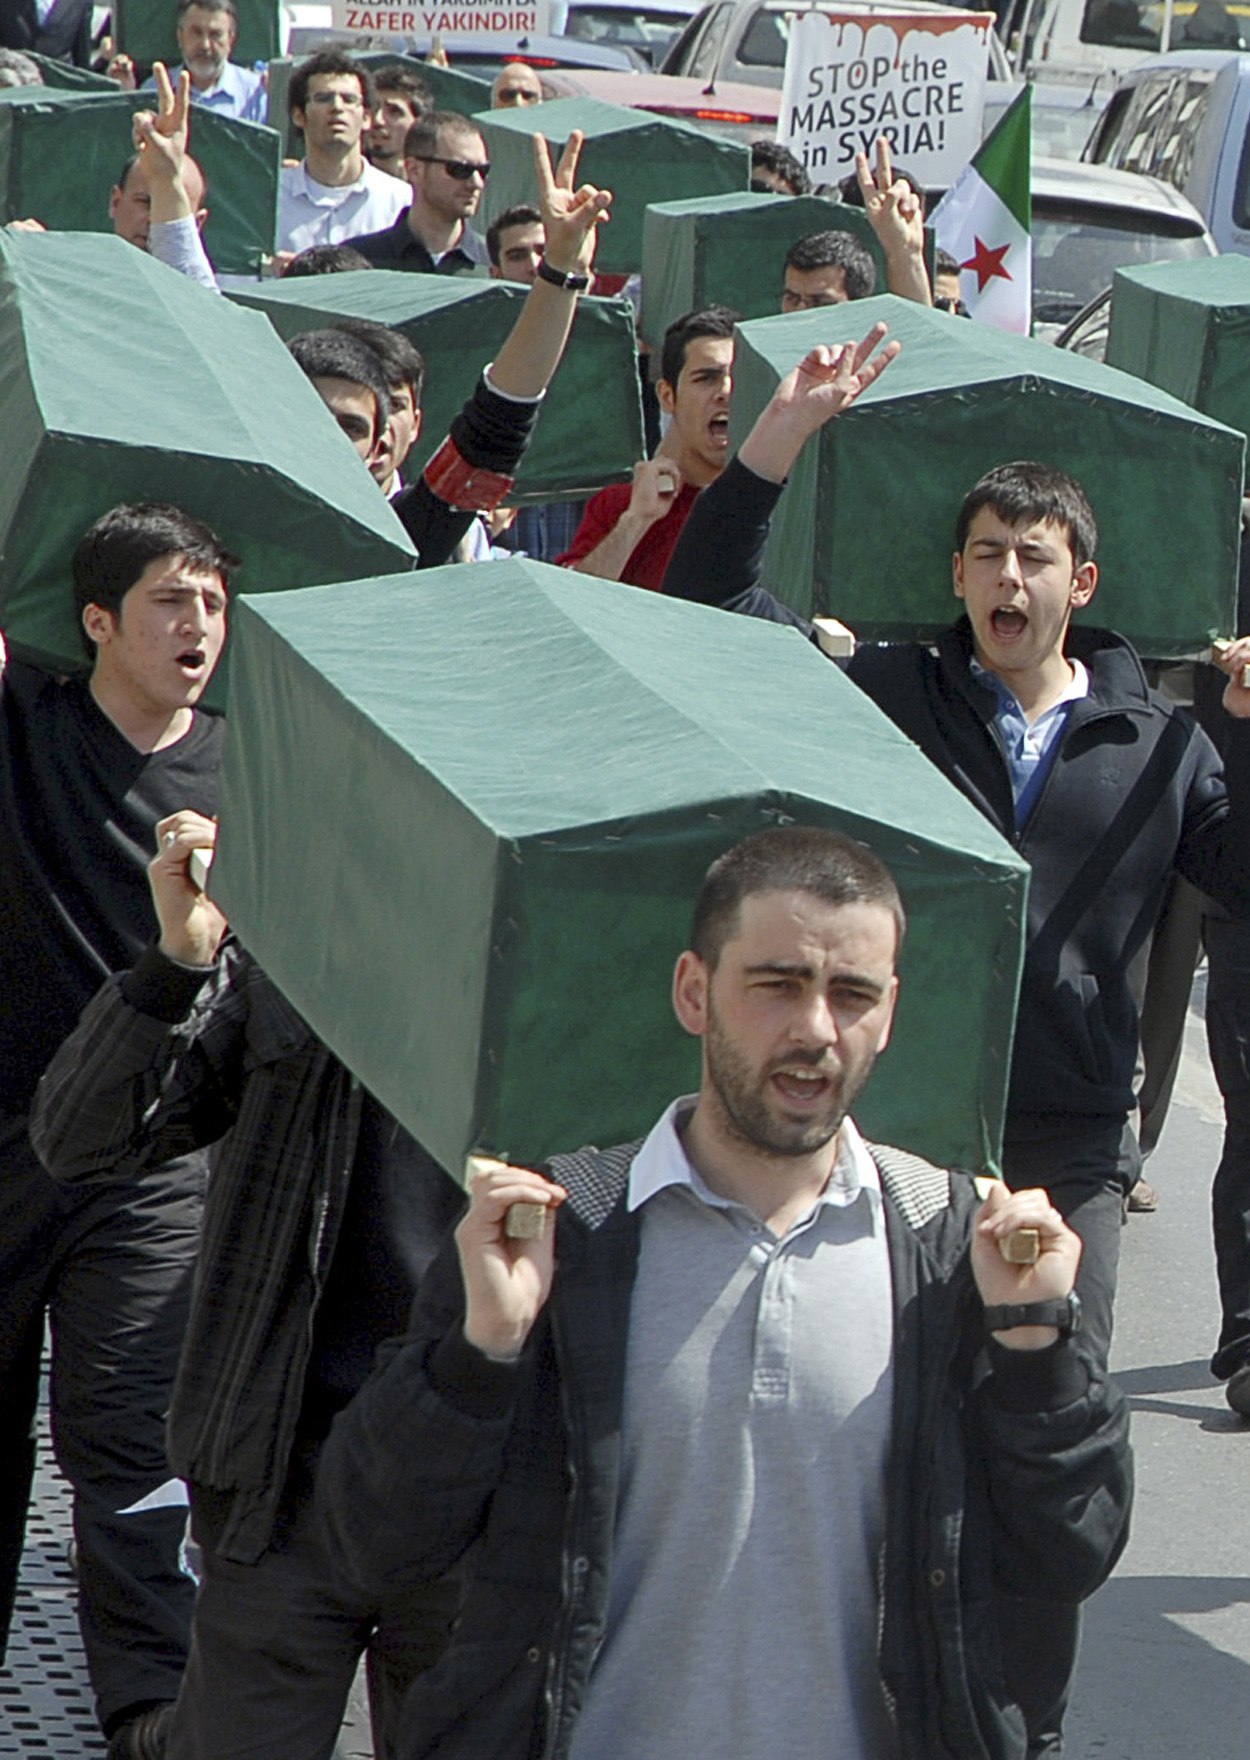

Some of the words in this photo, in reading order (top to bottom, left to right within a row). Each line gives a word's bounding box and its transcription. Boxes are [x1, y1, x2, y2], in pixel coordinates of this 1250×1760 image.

[346, 10, 415, 31] ZAFER
[423, 12, 535, 31] YAKINDIR!
[808, 56, 890, 98] STOP
[901, 54, 948, 83] the
[790, 82, 964, 137] MASSACRE
[802, 141, 827, 168] in
[837, 121, 945, 164] SYRIA!
